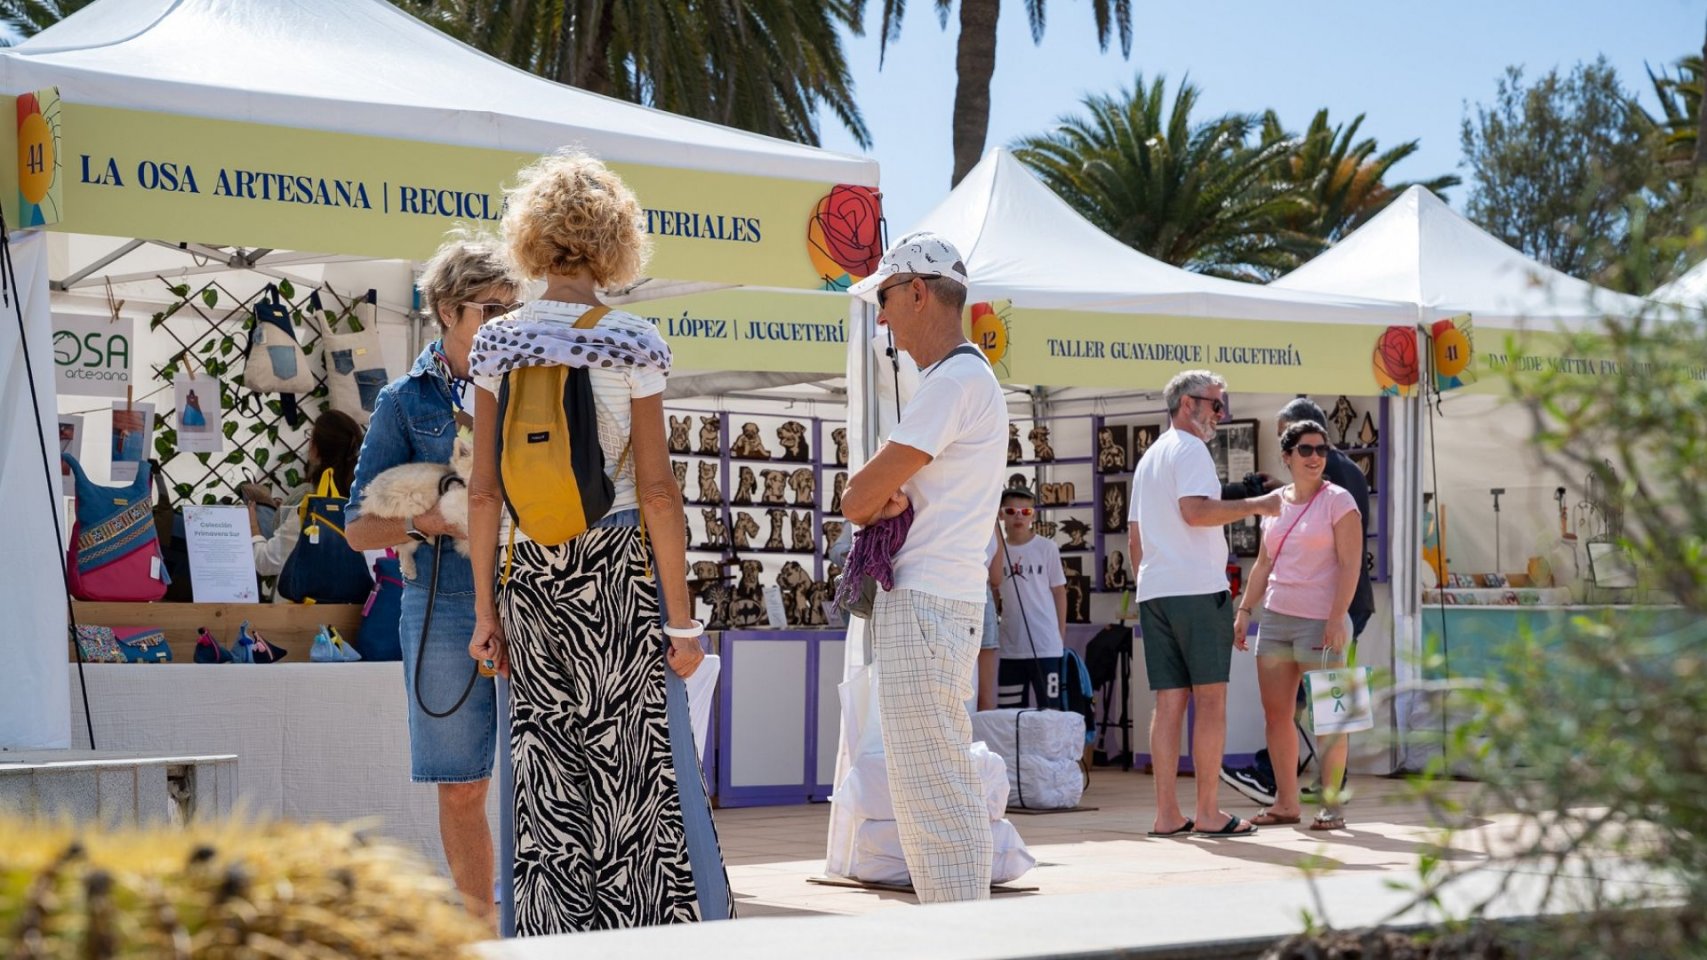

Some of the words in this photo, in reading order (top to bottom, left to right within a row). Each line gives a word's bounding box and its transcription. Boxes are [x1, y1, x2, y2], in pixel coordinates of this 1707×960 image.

[26, 143, 44, 175] 44
[80, 154, 125, 188] LA
[138, 160, 201, 194] OSA
[213, 168, 372, 210] ARTESANA
[642, 208, 761, 243] TERIALES
[667, 310, 728, 339] LÓPEZ
[744, 318, 850, 343] JUGUETERÍ
[980, 331, 996, 350] 42
[53, 330, 129, 370] OSA
[1046, 338, 1106, 359] TALLER
[1110, 341, 1202, 365] GUAYADEQUE
[1215, 342, 1303, 367] JUGUETERÍA
[1445, 344, 1458, 361] 41
[65, 368, 129, 382] artesana
[1047, 672, 1059, 699] 8
